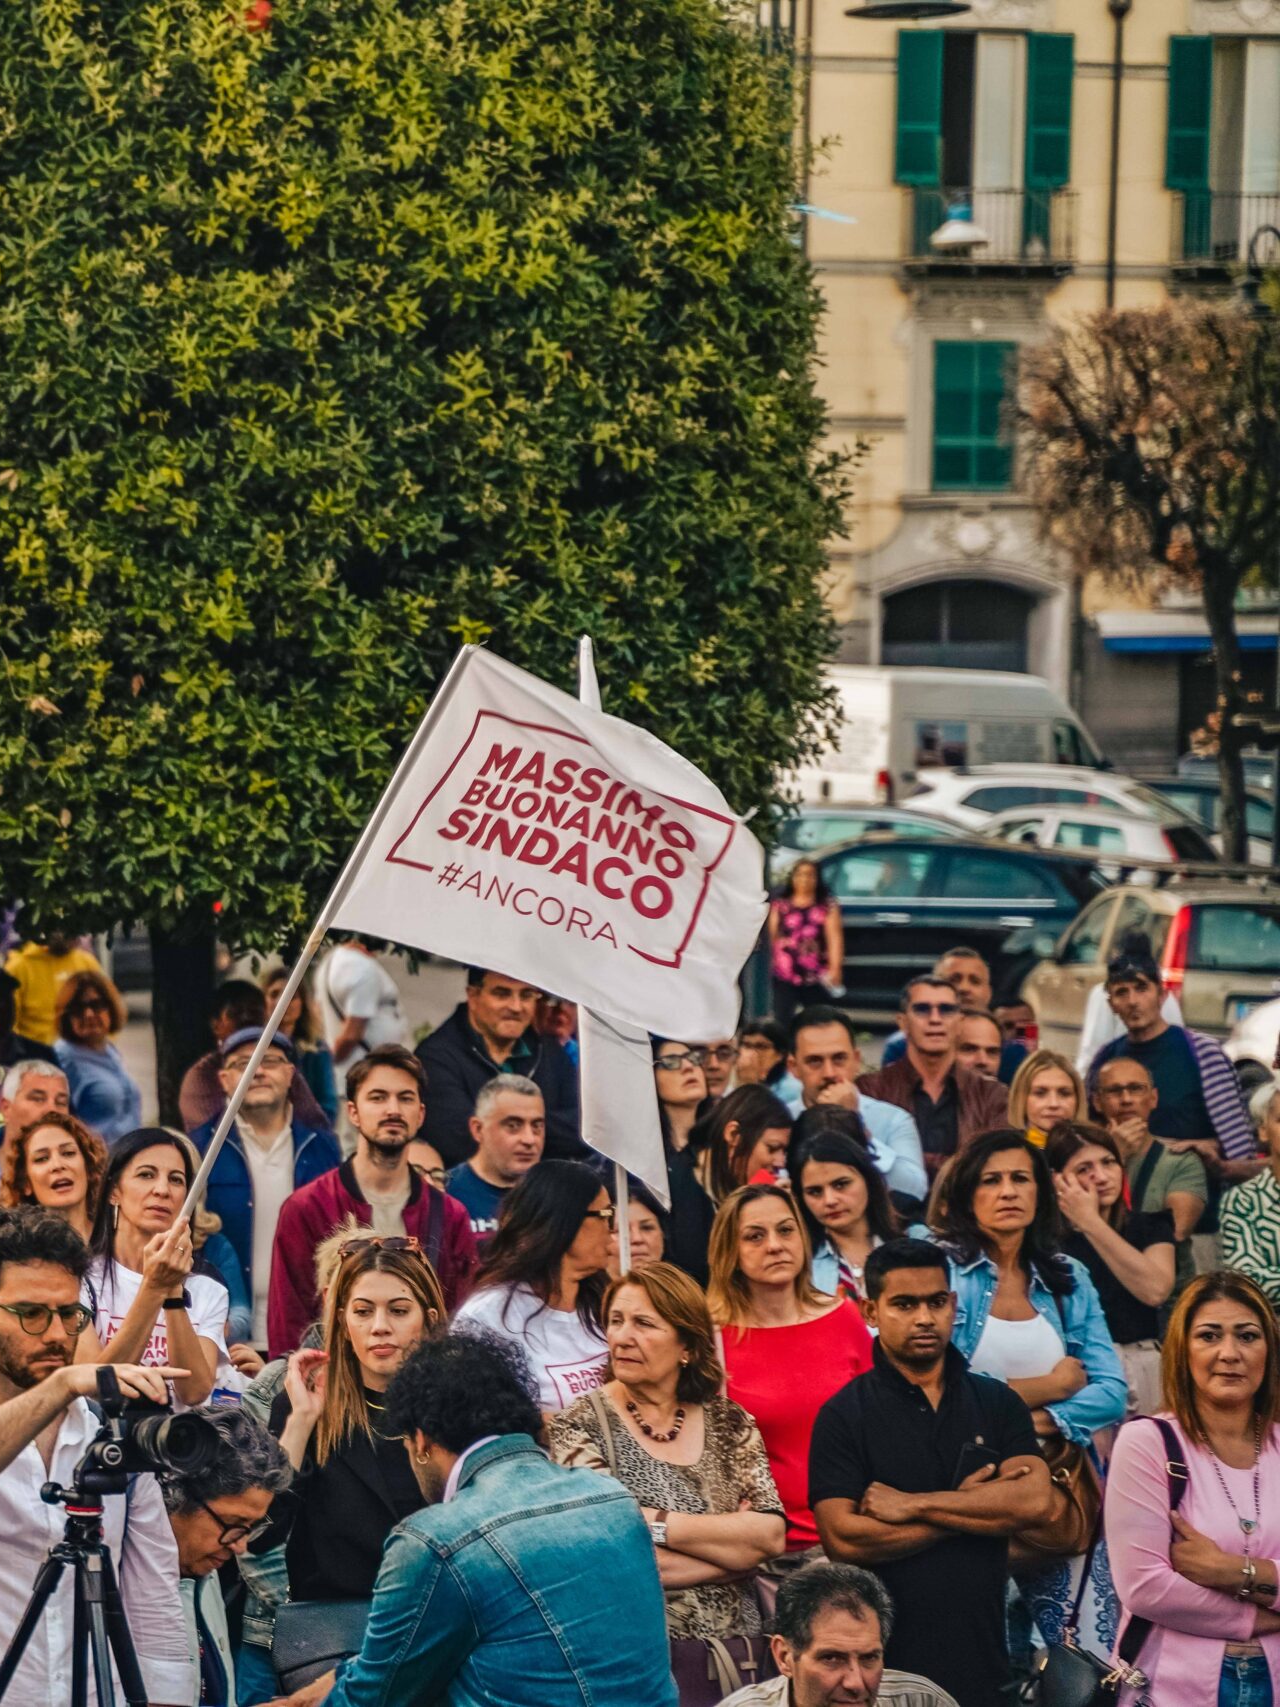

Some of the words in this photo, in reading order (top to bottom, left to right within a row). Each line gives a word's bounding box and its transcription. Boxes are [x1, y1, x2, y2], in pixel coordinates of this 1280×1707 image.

[459, 778, 685, 879] BUONANNO
[477, 743, 696, 852] MASSIMO
[437, 807, 674, 919] SINDACO
[437, 861, 618, 949] #ANCORA
